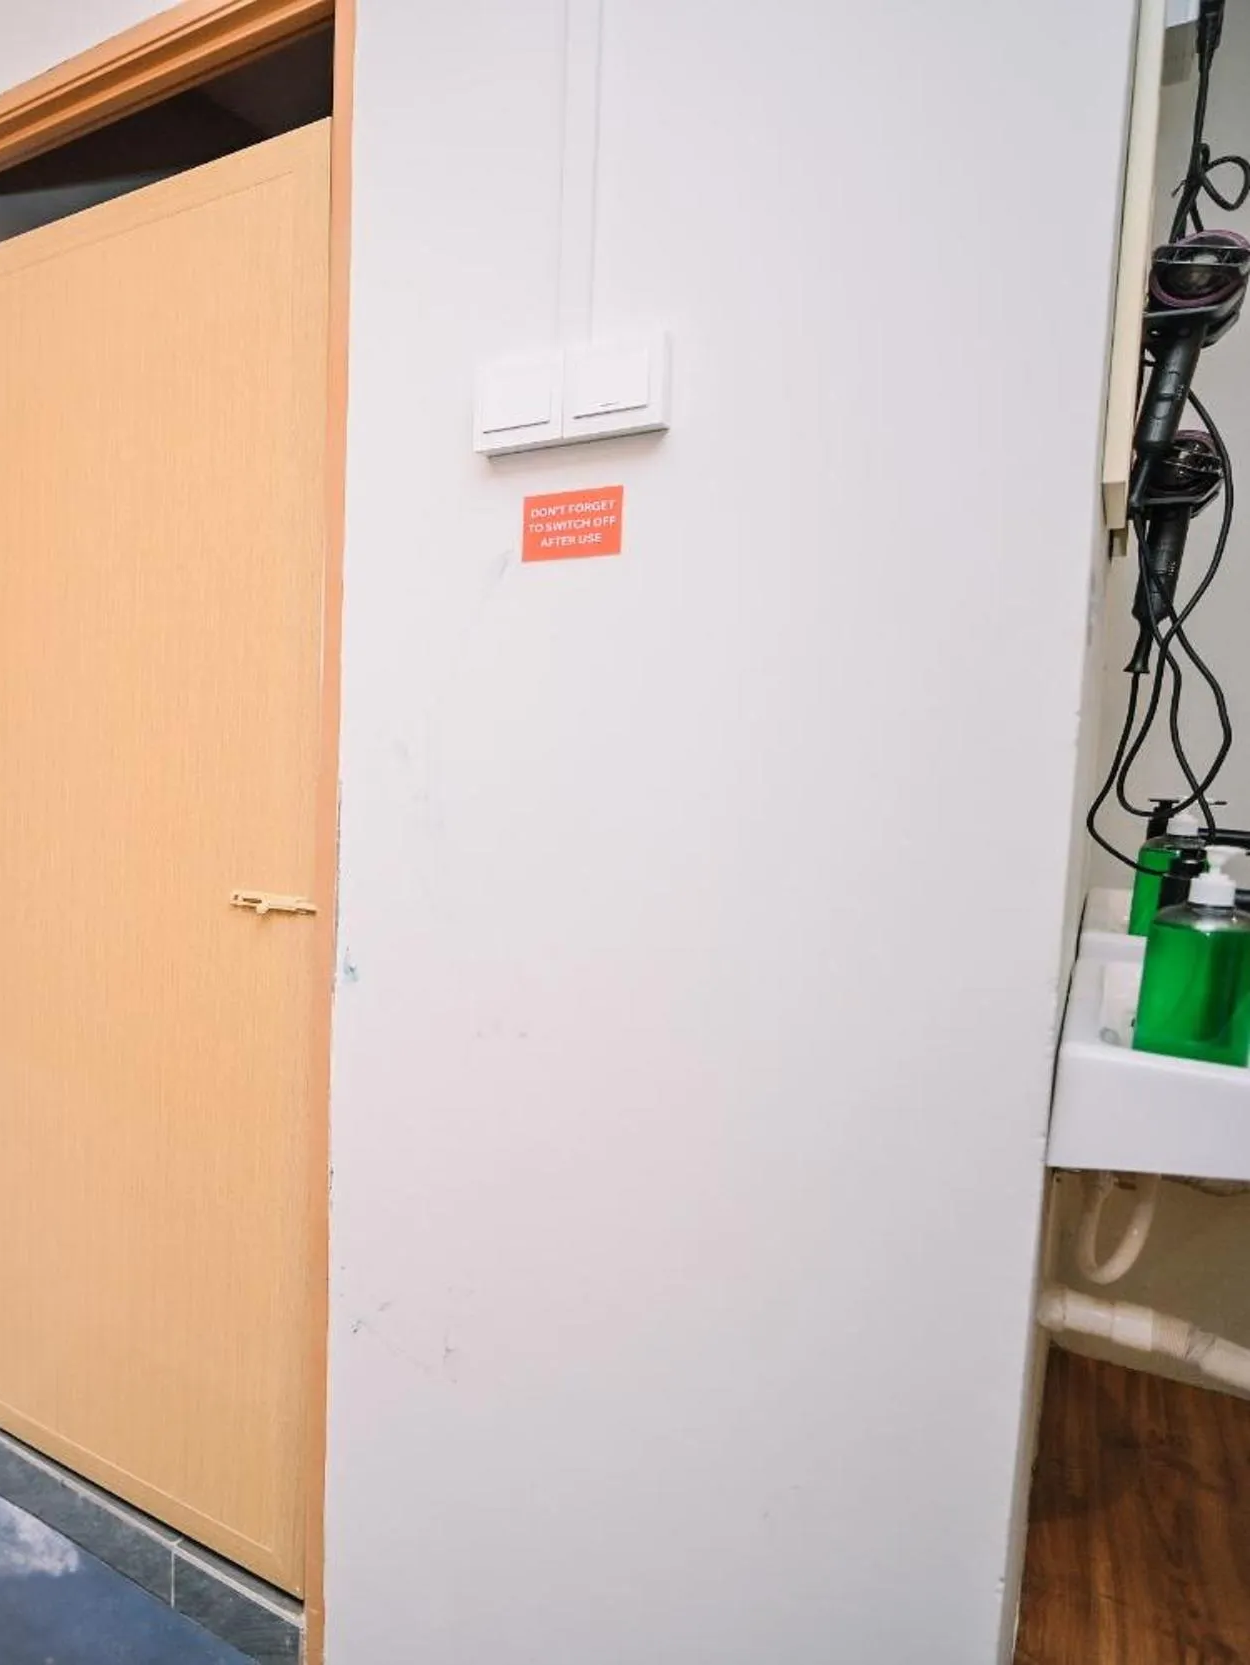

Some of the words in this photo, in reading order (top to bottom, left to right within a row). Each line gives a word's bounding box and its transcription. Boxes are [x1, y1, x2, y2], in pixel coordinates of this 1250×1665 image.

[531, 505, 565, 518] DON'T
[569, 500, 616, 514] FORGET
[528, 523, 544, 533] TO
[545, 518, 591, 532] SWITCH
[593, 515, 617, 527] OFF
[540, 535, 576, 548] AFTER
[577, 532, 603, 545] USE
